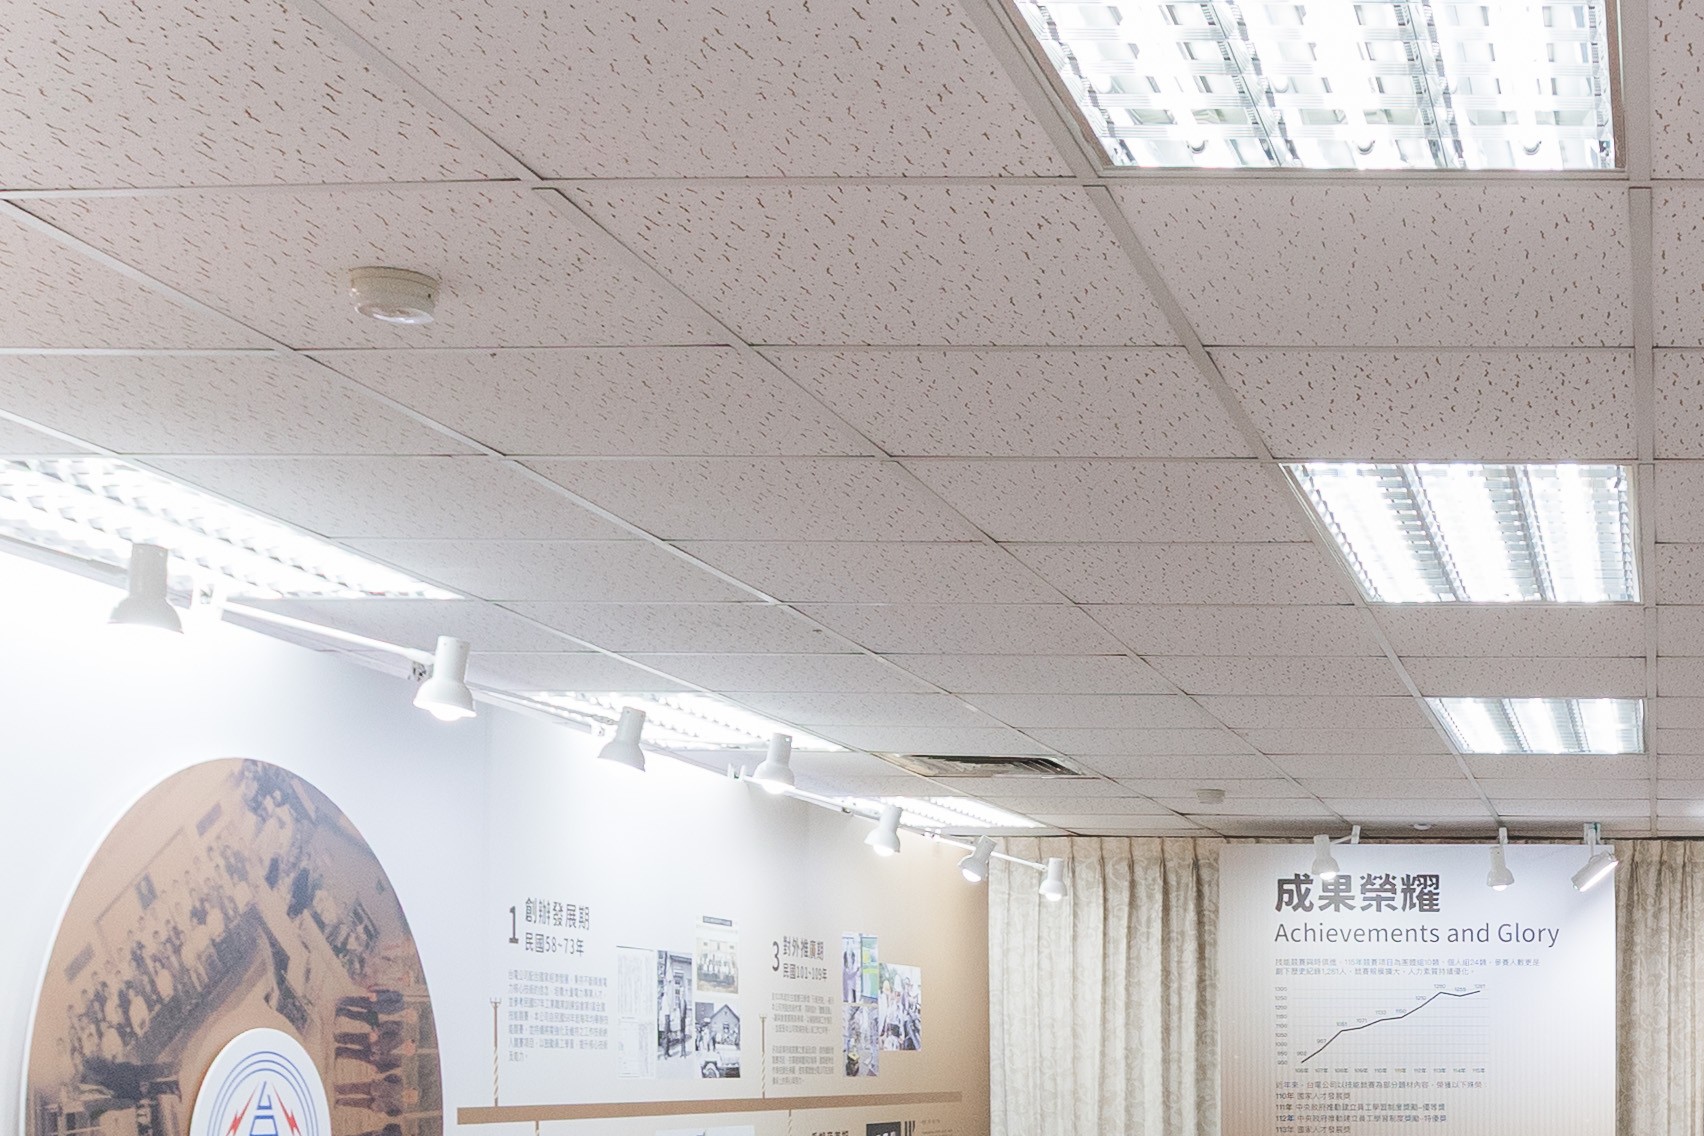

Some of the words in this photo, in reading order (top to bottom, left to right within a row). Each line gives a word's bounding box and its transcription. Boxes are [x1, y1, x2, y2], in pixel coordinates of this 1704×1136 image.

[1274, 873, 1441, 913] 成果榮耀
[509, 906, 519, 944] 1
[525, 897, 590, 931] 創辦發展期
[1274, 922, 1440, 943] Achievements
[1447, 922, 1490, 943] and
[1497, 922, 1560, 948] Glory
[772, 941, 780, 972] 3
